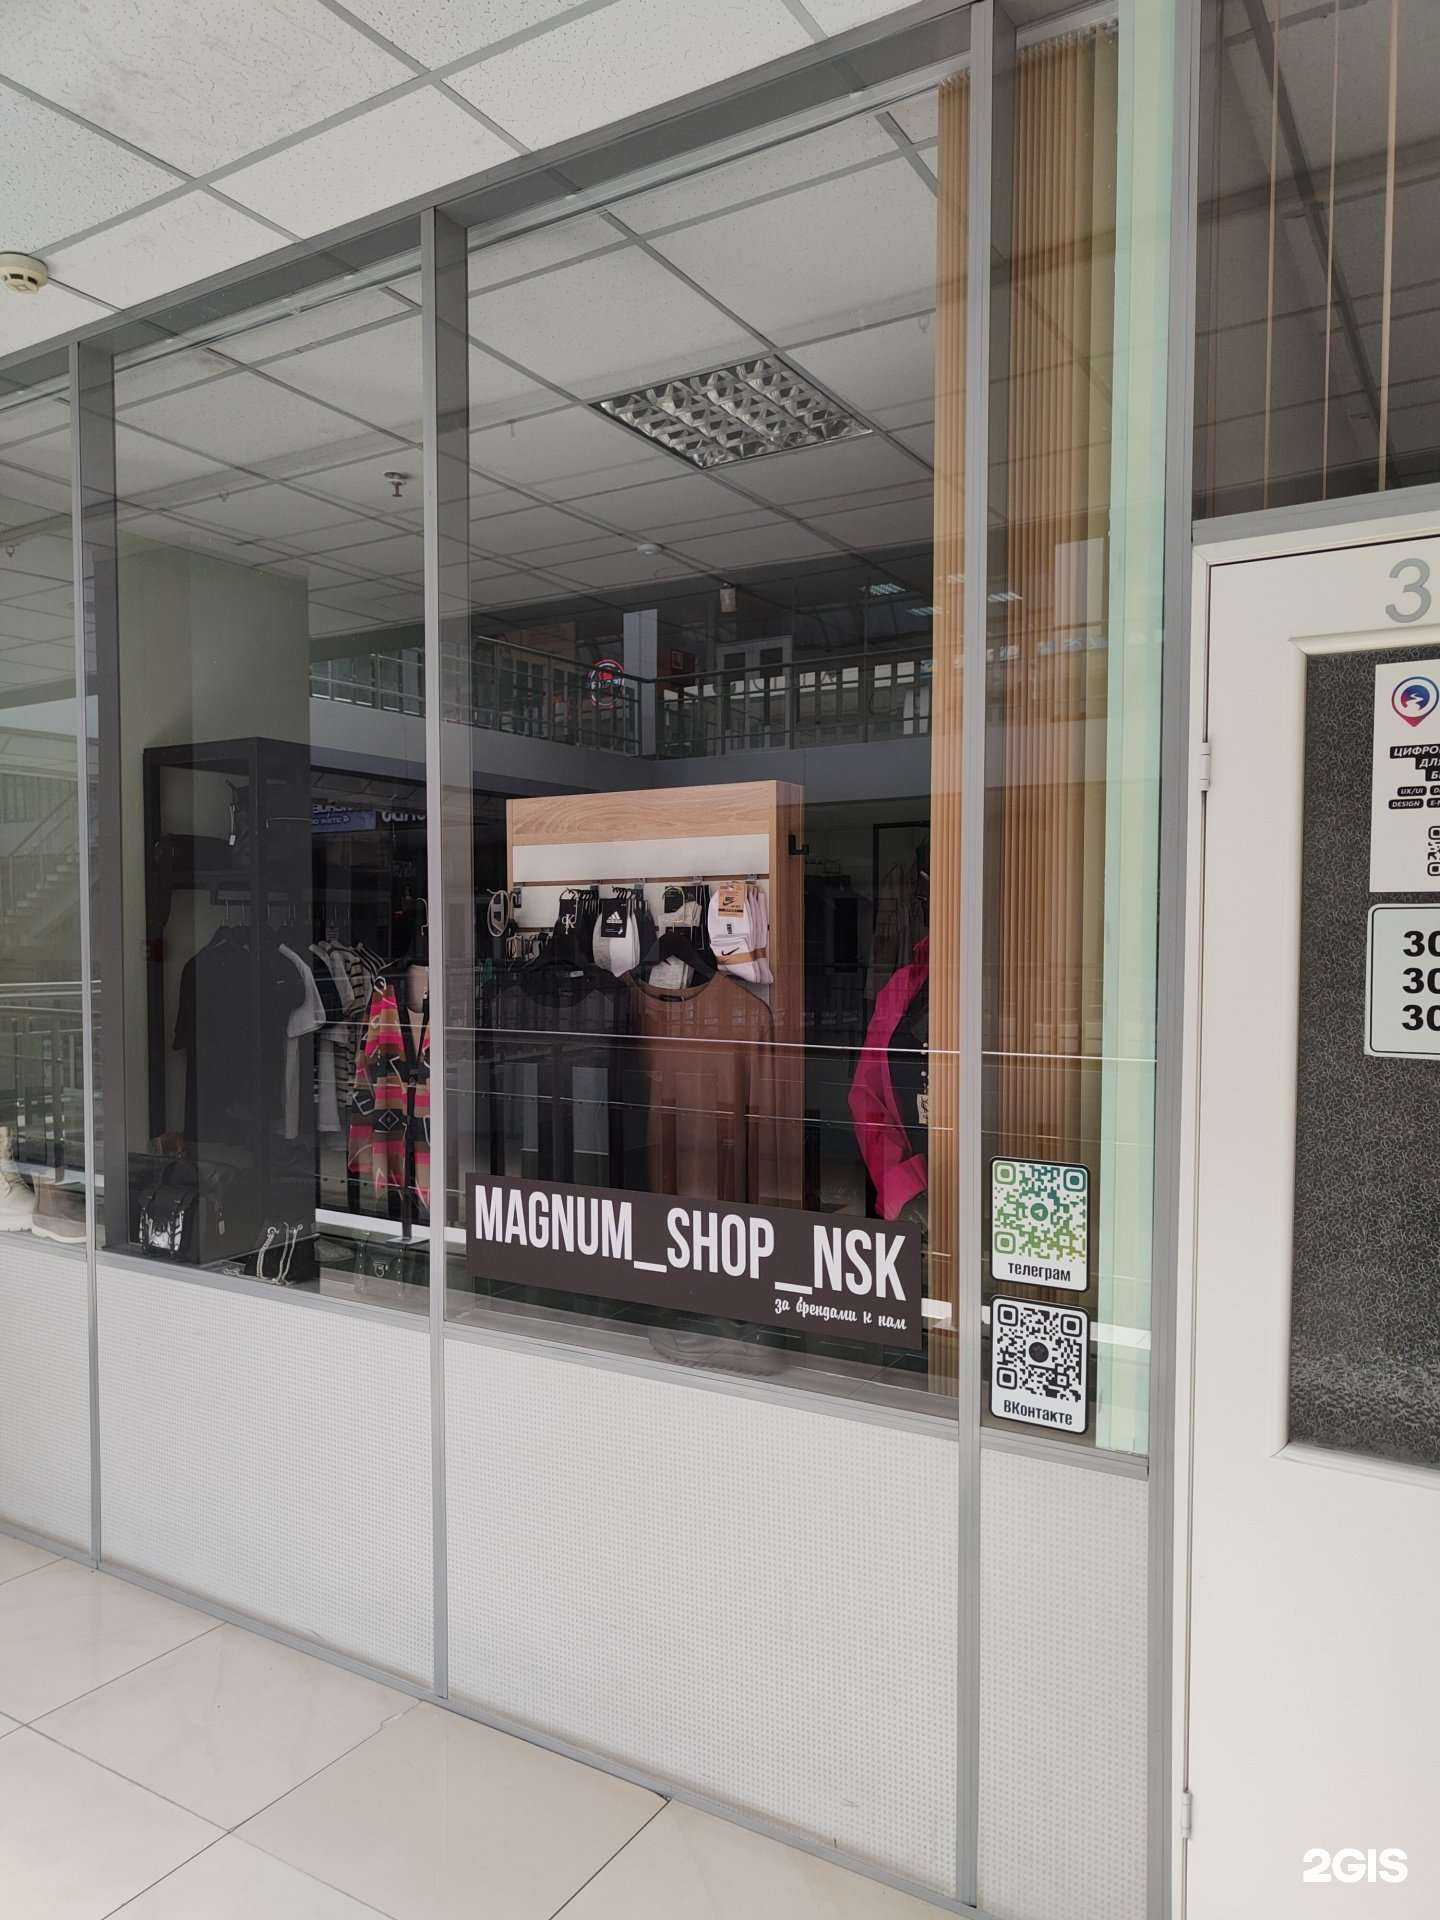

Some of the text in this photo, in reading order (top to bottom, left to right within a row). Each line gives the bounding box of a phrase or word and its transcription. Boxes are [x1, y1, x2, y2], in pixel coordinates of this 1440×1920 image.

[1385, 558, 1432, 624] 3
[1393, 745, 1440, 757] ЦИФРО
[1392, 800, 1420, 808] DESIGN
[1402, 930, 1440, 957] 30
[1402, 967, 1440, 995] 30
[1401, 1004, 1440, 1031] 30
[475, 1184, 907, 1301] MAGNUM_SHOP_NSK
[1008, 1262, 1071, 1282] телеграм
[774, 1296, 908, 1331] за брендами к нам
[1003, 1399, 1073, 1426] ВКонтакте
